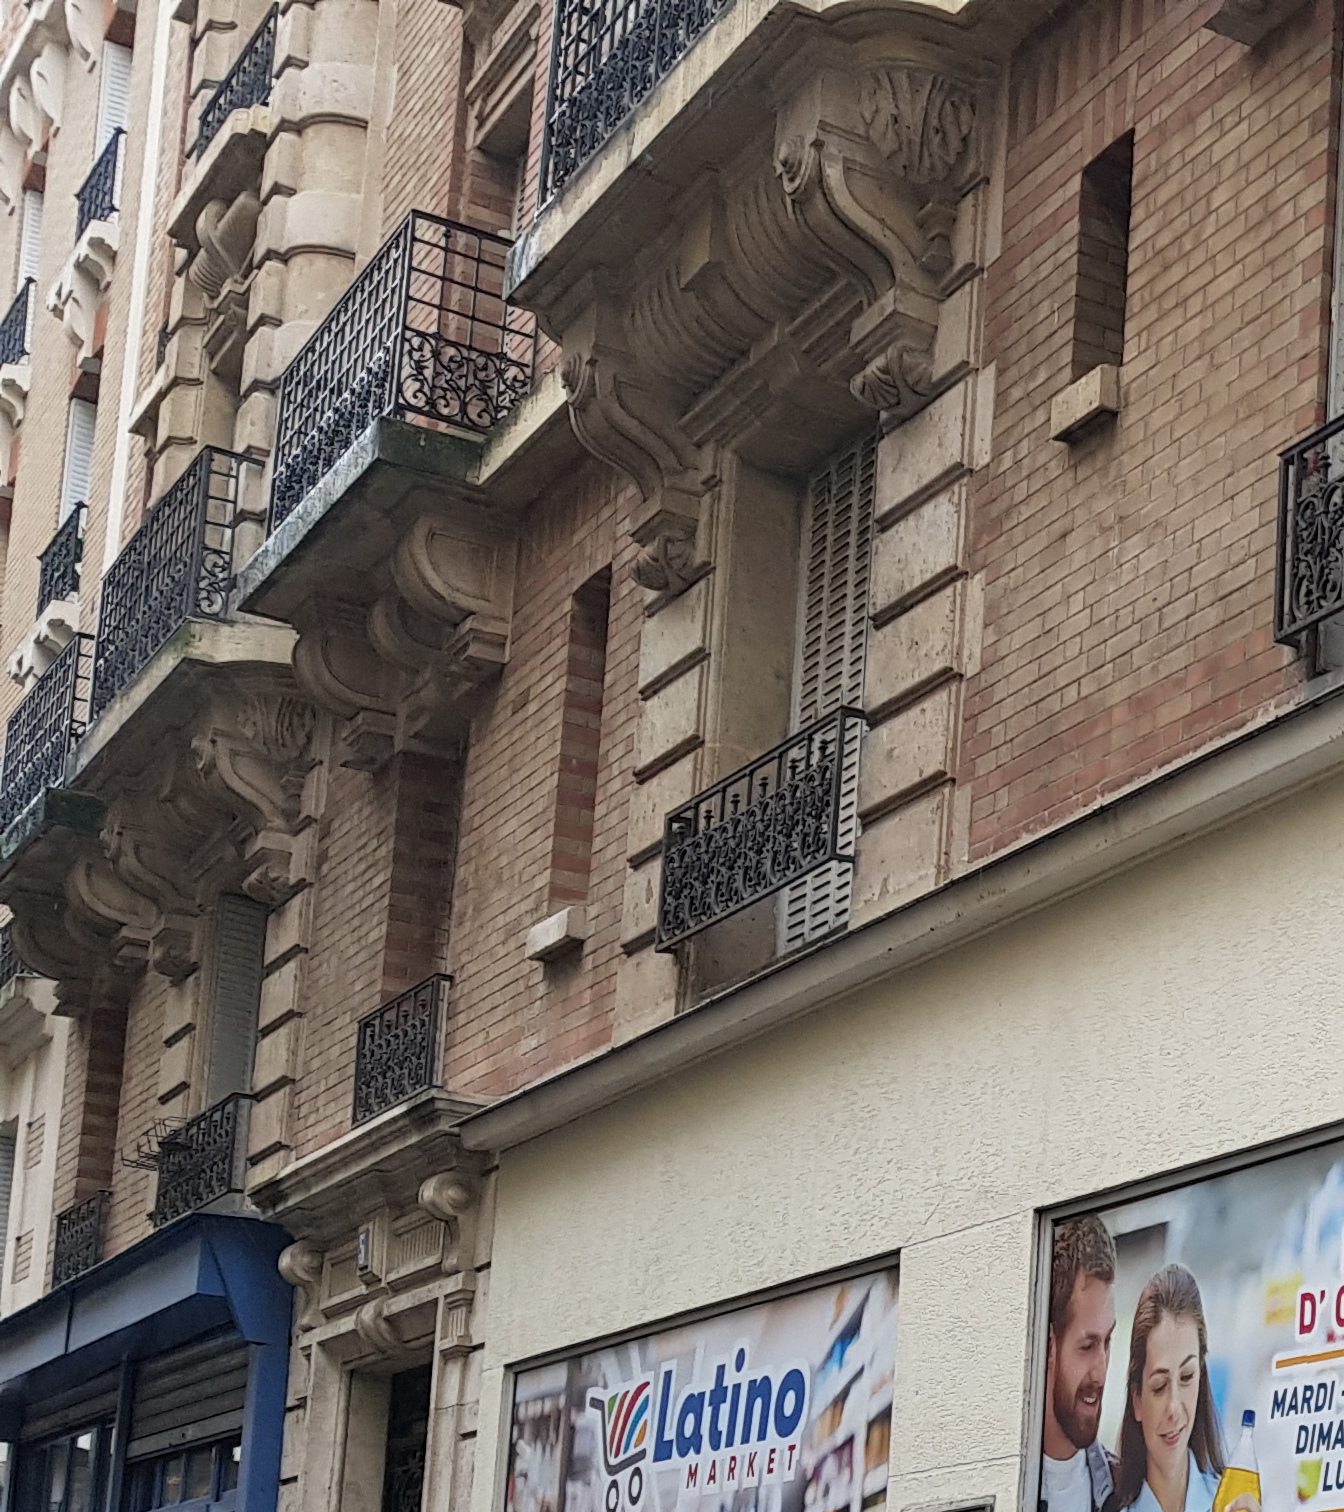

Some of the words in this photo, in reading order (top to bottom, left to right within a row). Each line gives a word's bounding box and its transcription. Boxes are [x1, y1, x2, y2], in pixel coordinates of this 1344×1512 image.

[653, 1348, 806, 1463] Latino
[1271, 1380, 1335, 1420] MARDI
[686, 1444, 796, 1490] MARKET
